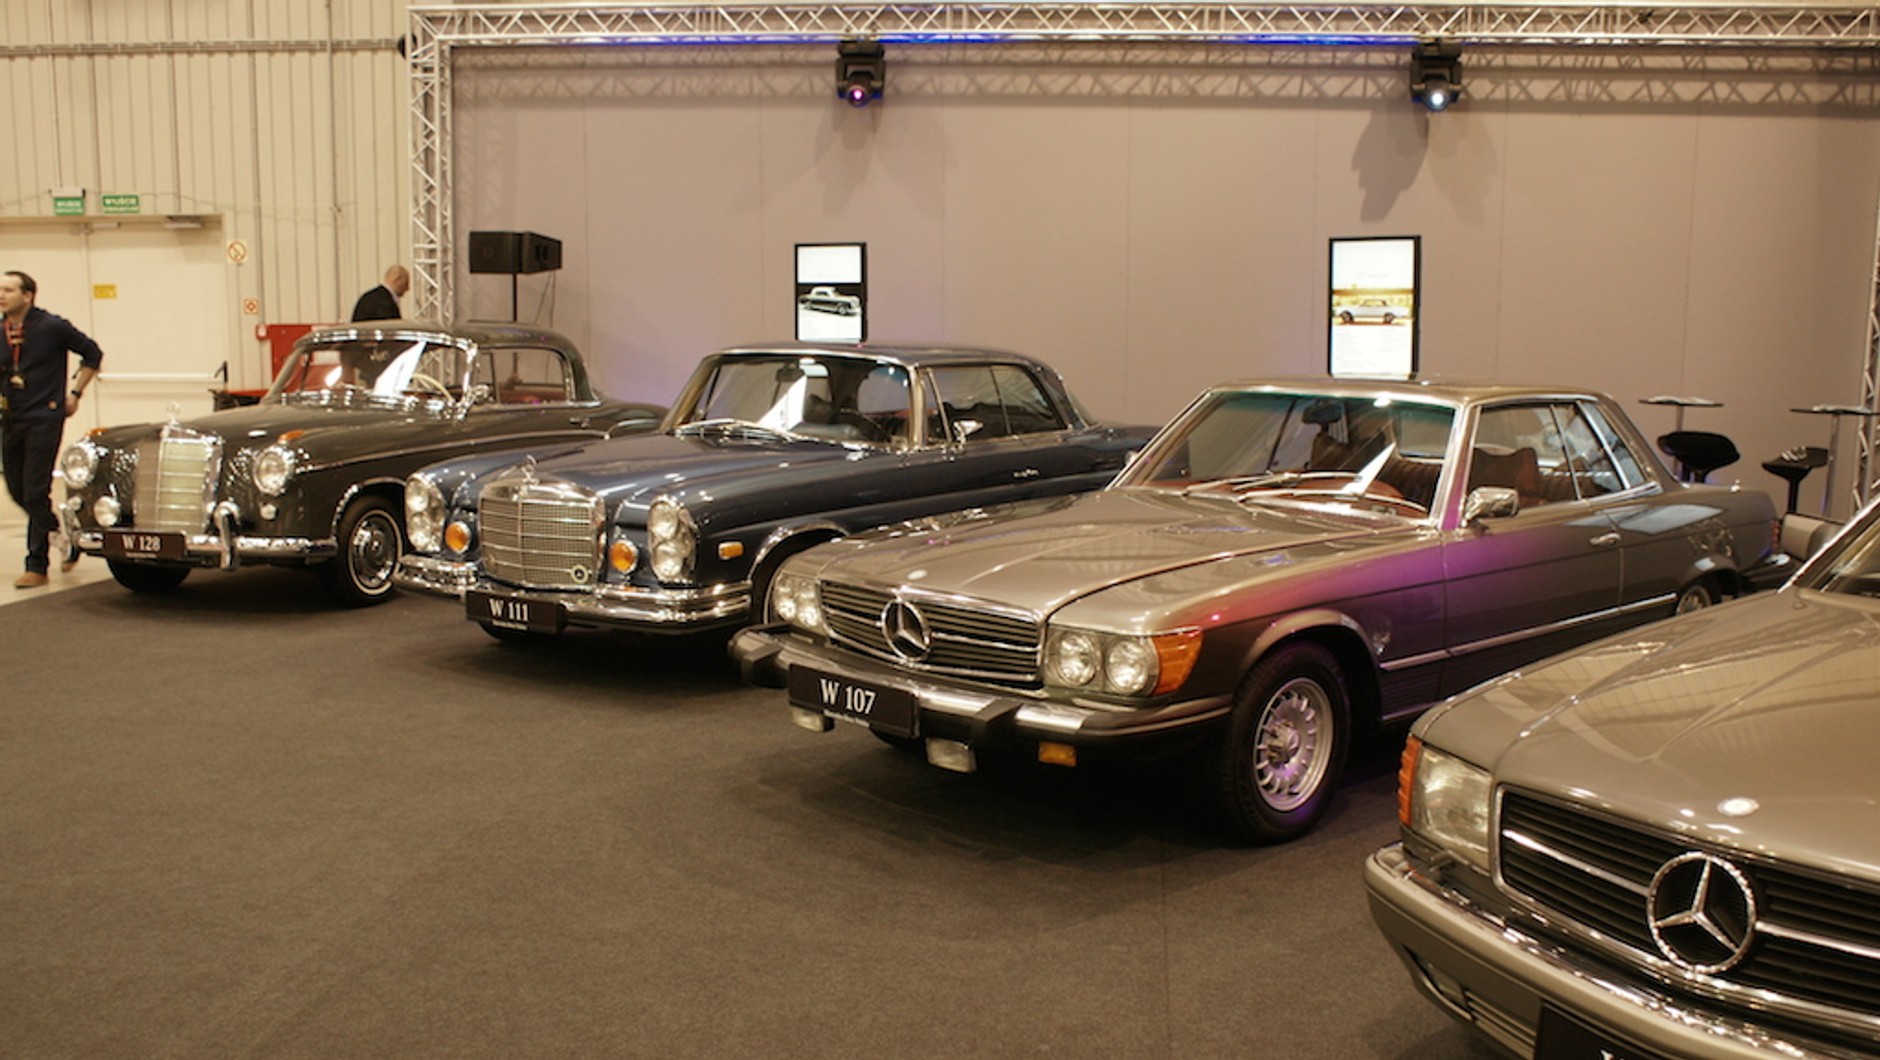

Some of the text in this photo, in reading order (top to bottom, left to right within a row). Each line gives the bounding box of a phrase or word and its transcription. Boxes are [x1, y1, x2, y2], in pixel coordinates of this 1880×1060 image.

[122, 534, 161, 552] W 128
[488, 598, 529, 622] W 111
[820, 678, 876, 715] W 107
